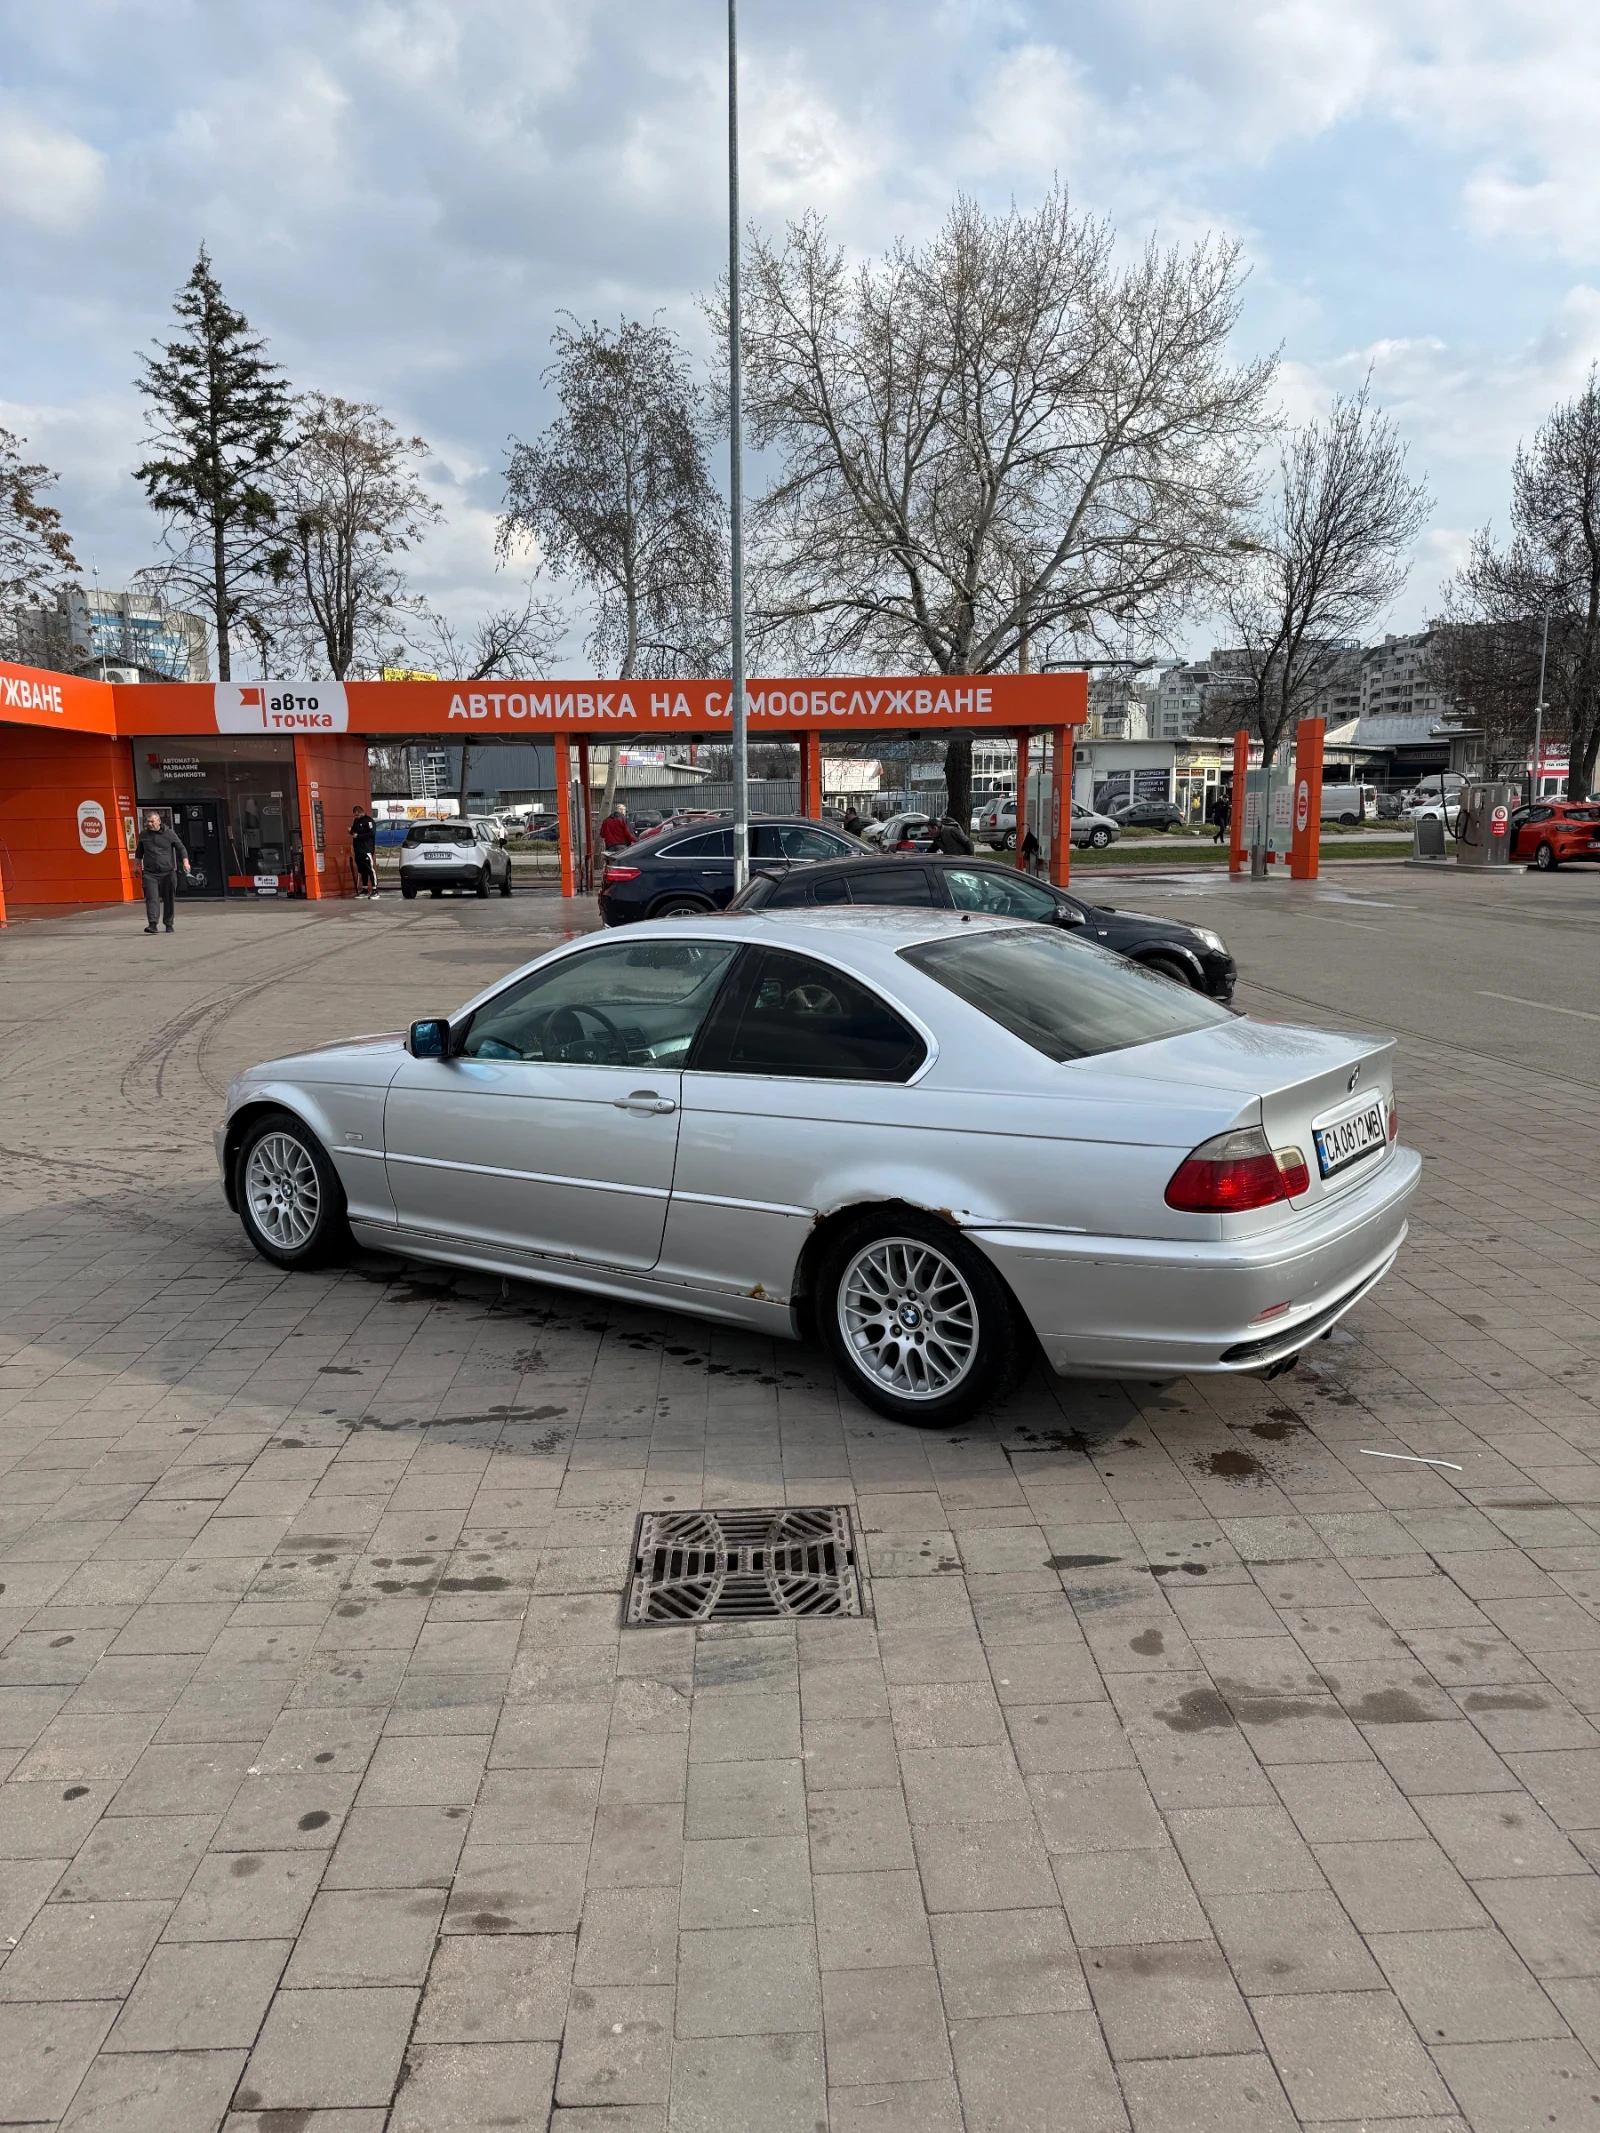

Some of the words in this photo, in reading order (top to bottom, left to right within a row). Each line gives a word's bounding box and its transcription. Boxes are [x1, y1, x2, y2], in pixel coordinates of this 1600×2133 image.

[0, 677, 64, 714] ЖВАНЕ
[270, 693, 319, 711] авто
[448, 693, 637, 718] АВТОМИВКА
[651, 692, 692, 717] НА
[272, 713, 333, 727] точка
